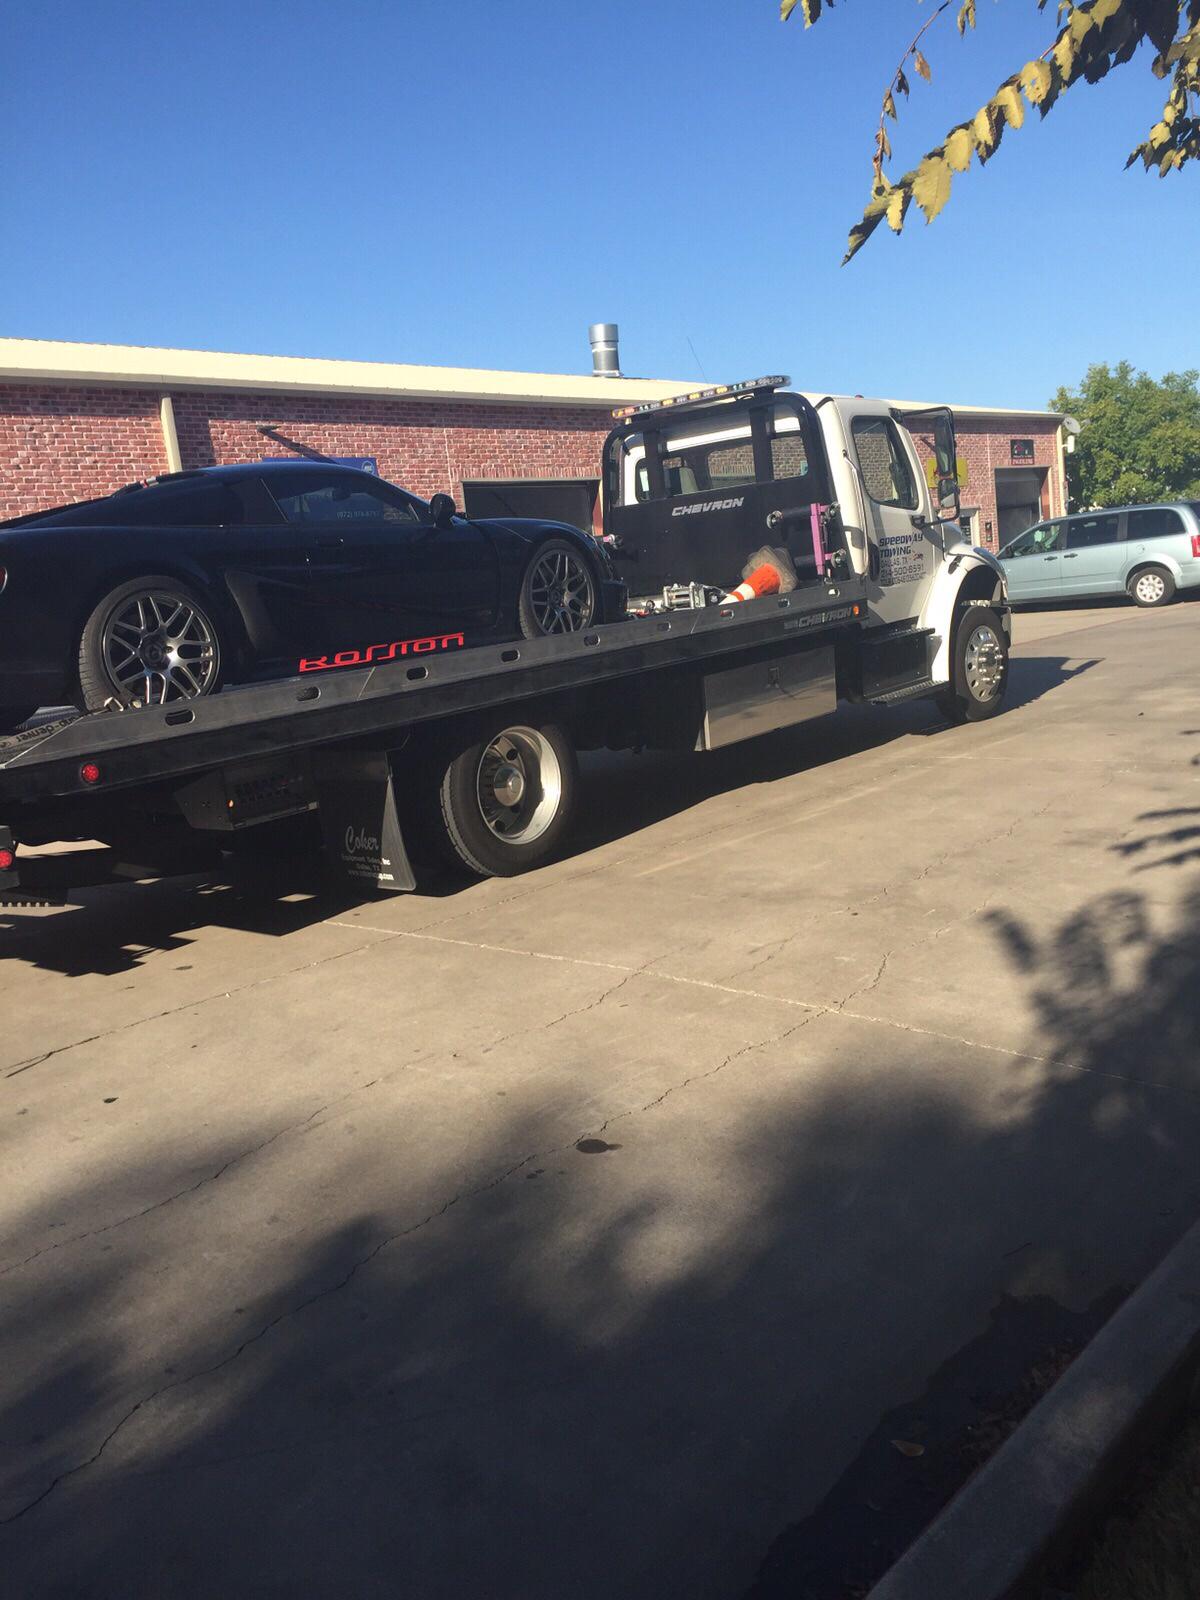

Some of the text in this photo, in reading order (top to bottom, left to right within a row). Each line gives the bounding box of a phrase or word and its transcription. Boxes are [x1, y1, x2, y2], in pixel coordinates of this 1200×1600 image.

[671, 497, 744, 516] CHEVRON
[880, 545, 912, 558] TOWING
[345, 825, 379, 854] Coker
